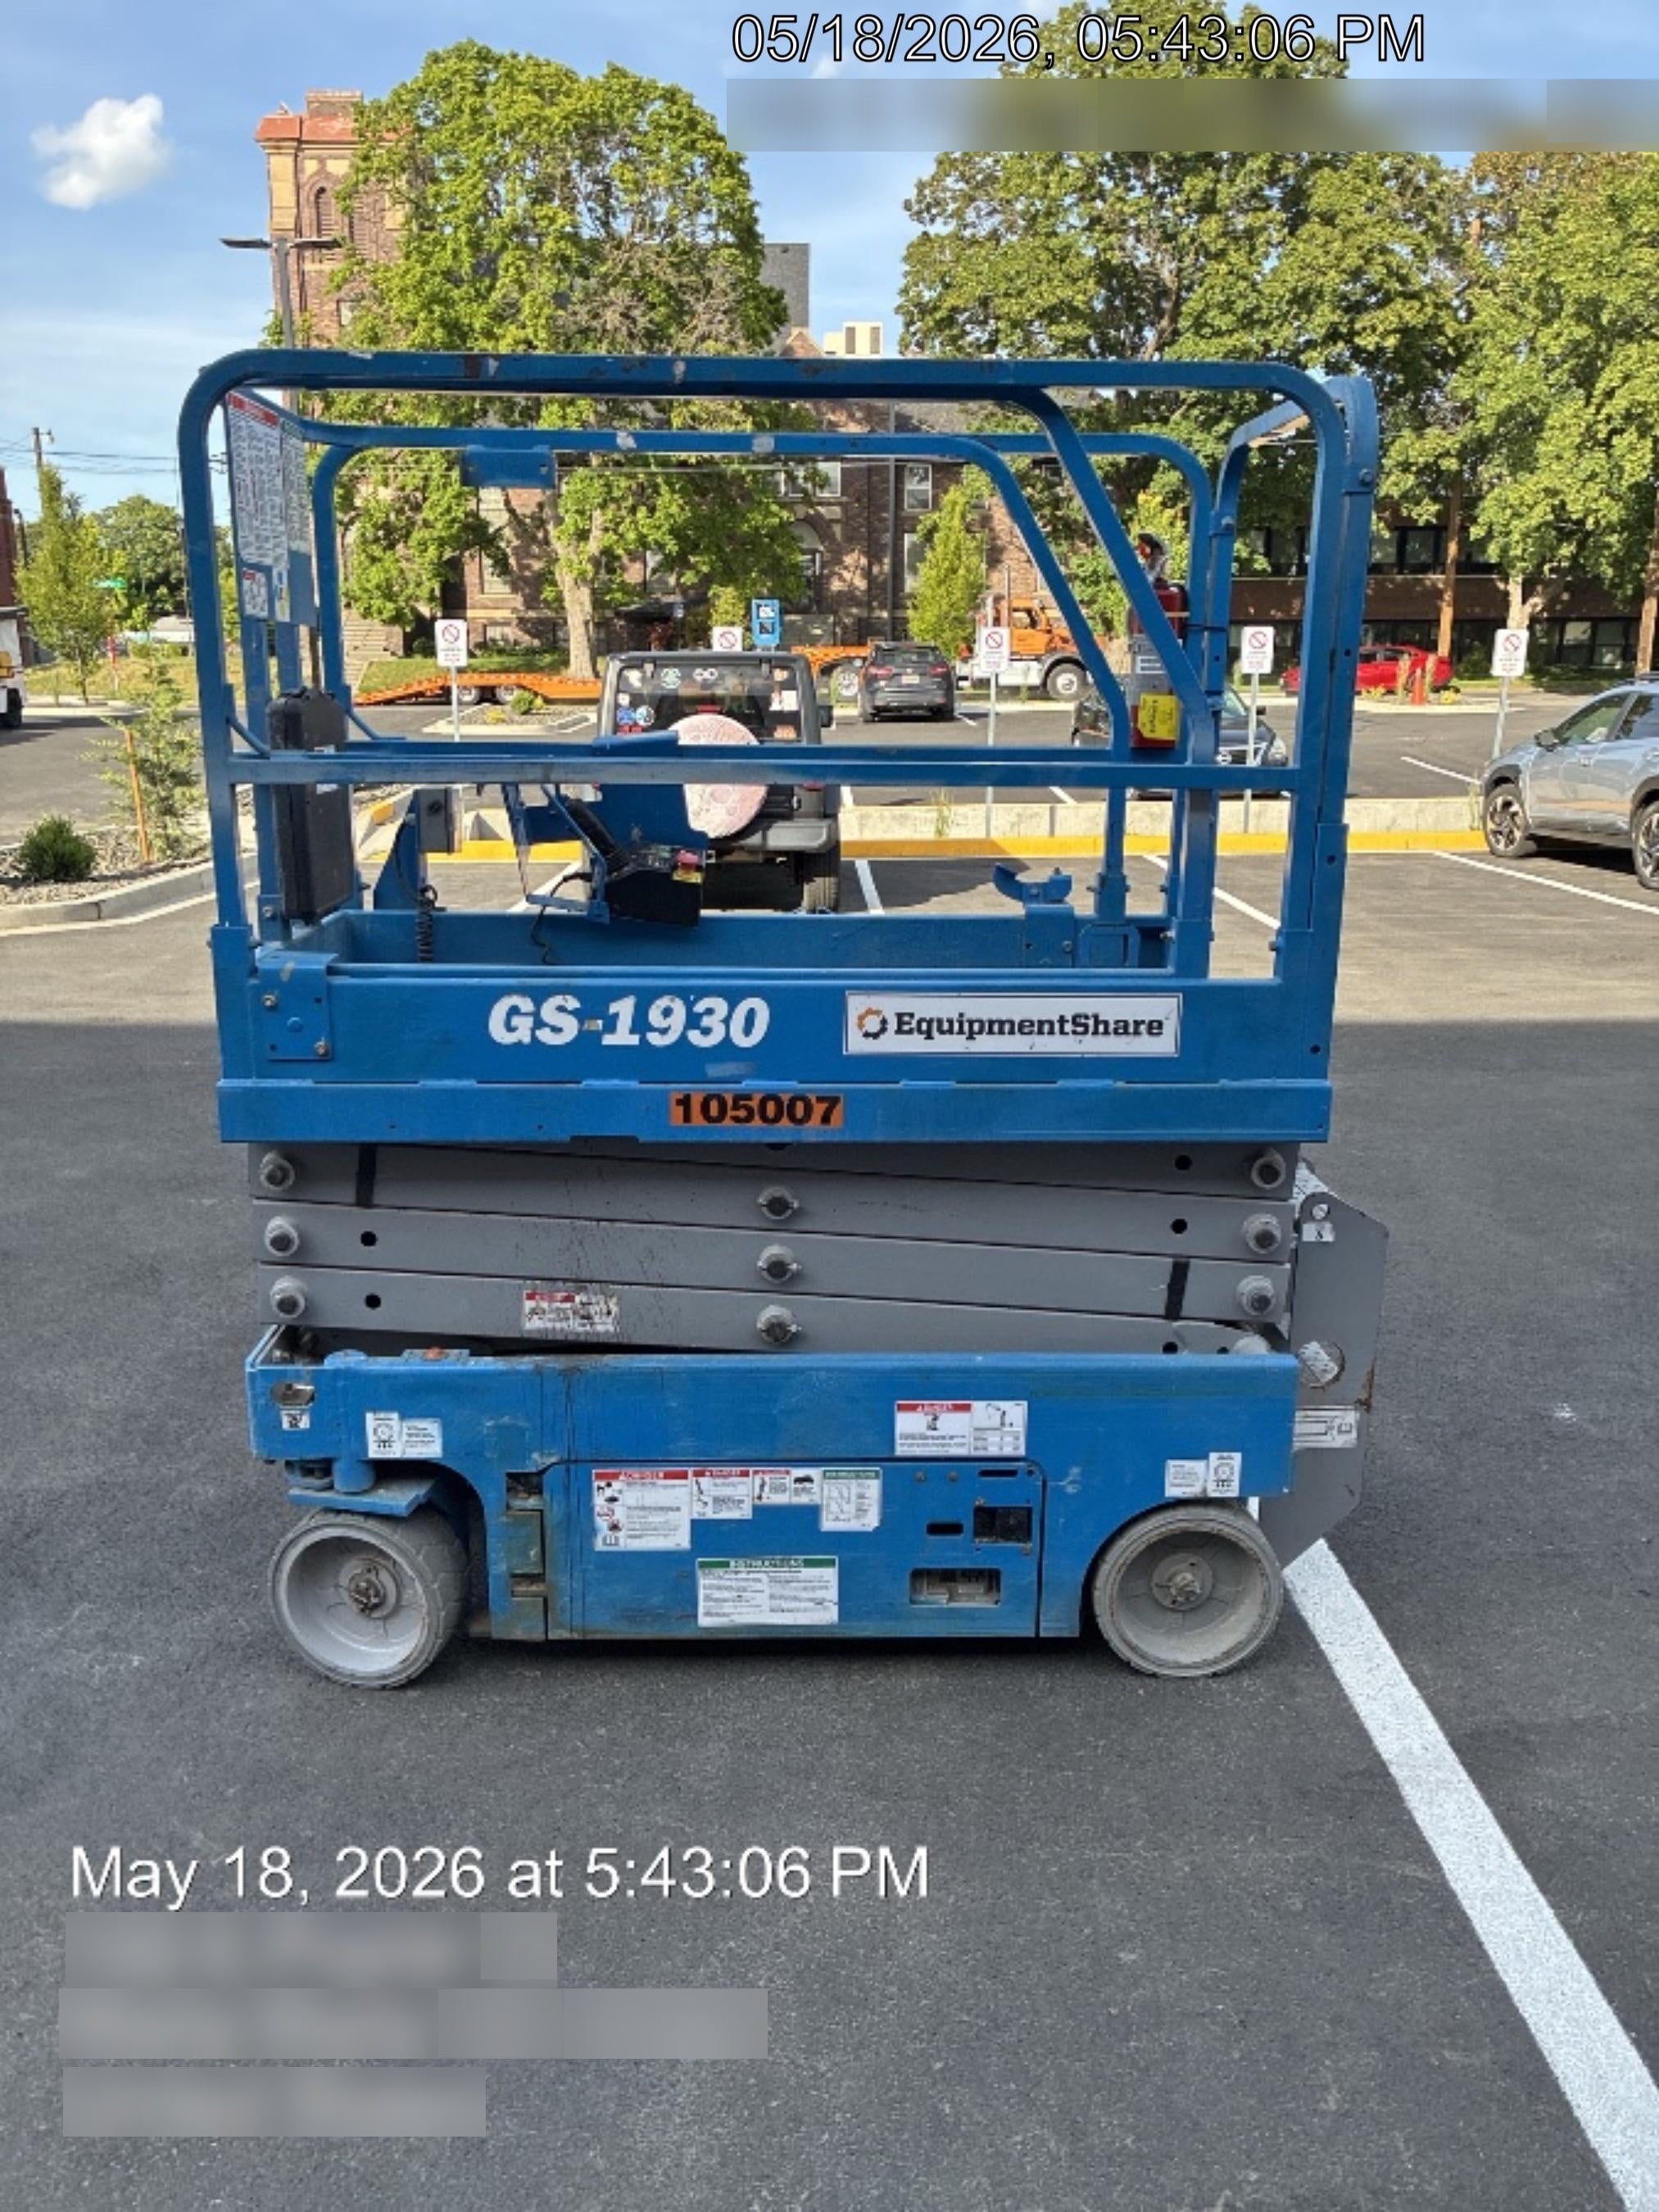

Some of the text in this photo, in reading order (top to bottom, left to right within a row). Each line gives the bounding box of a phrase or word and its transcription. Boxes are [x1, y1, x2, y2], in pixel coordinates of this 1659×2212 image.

[488, 995, 771, 1049] GS-1930
[894, 1012, 1165, 1041] EquipmentShare
[673, 1094, 842, 1126] 105007
